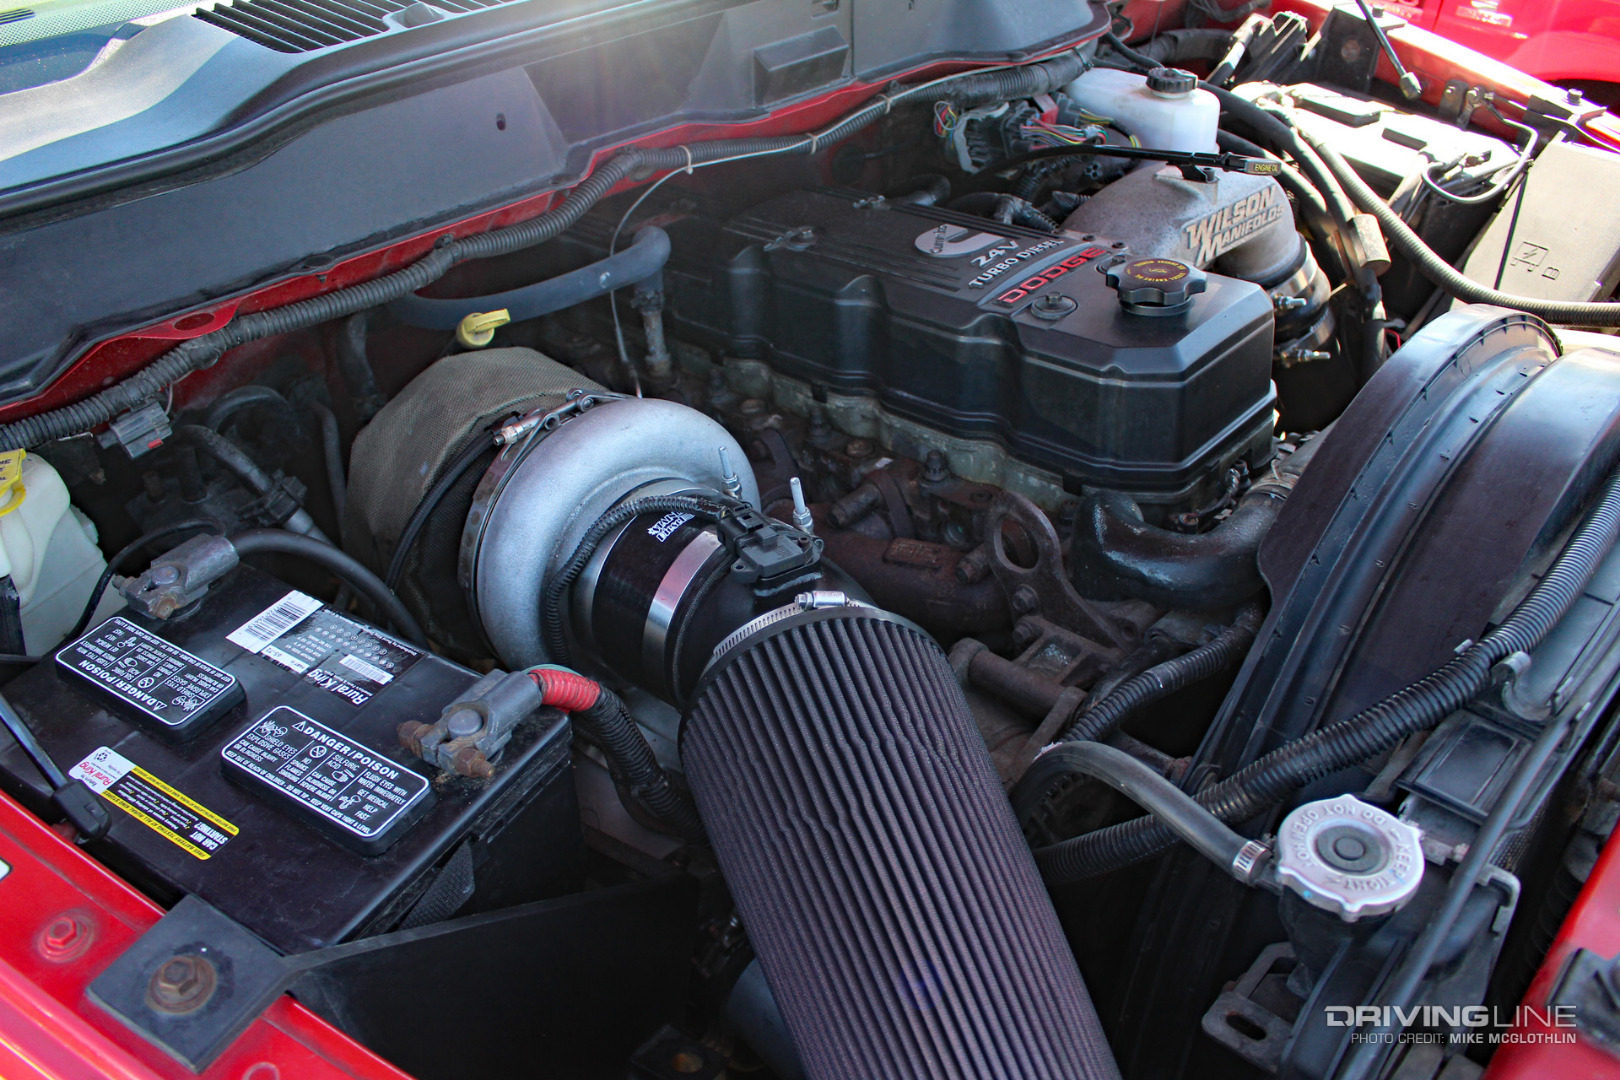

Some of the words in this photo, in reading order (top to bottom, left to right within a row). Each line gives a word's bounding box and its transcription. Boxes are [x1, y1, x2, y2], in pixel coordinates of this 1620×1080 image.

[1254, 163, 1271, 171] ENGINE
[1186, 185, 1277, 249] WILSON
[1194, 204, 1285, 268] MANIFOLDS
[968, 256, 1020, 289] TURBO
[1016, 239, 1065, 262] DIESEL
[970, 240, 1020, 267] 24V
[998, 247, 1106, 305] DODGE
[76, 659, 158, 704] DANGER/POISON
[302, 667, 340, 688] King
[329, 683, 369, 705] Rural
[245, 733, 274, 749] EXPLOSIVE
[272, 748, 291, 759] GASES
[264, 735, 284, 746] SHIELD
[281, 744, 297, 753] EYES
[301, 726, 401, 778] DANGER/POISON
[76, 760, 99, 775] King
[326, 760, 341, 769] ACID
[331, 754, 360, 770] SULFURIC
[91, 771, 113, 786] Rural
[363, 771, 381, 782] FLUSH
[379, 780, 394, 789] EYES
[392, 786, 407, 795] WITH
[357, 777, 375, 788] WATER
[372, 786, 406, 804] IMMEDIATELY
[354, 810, 370, 820] FAST
[362, 804, 378, 813] HELP
[1323, 804, 1356, 816] NOT
[1362, 809, 1386, 825] DO
[188, 830, 206, 842] NOT
[193, 820, 229, 844] STARTING?
[1291, 810, 1318, 841] OPEN
[200, 837, 219, 850] CAR
